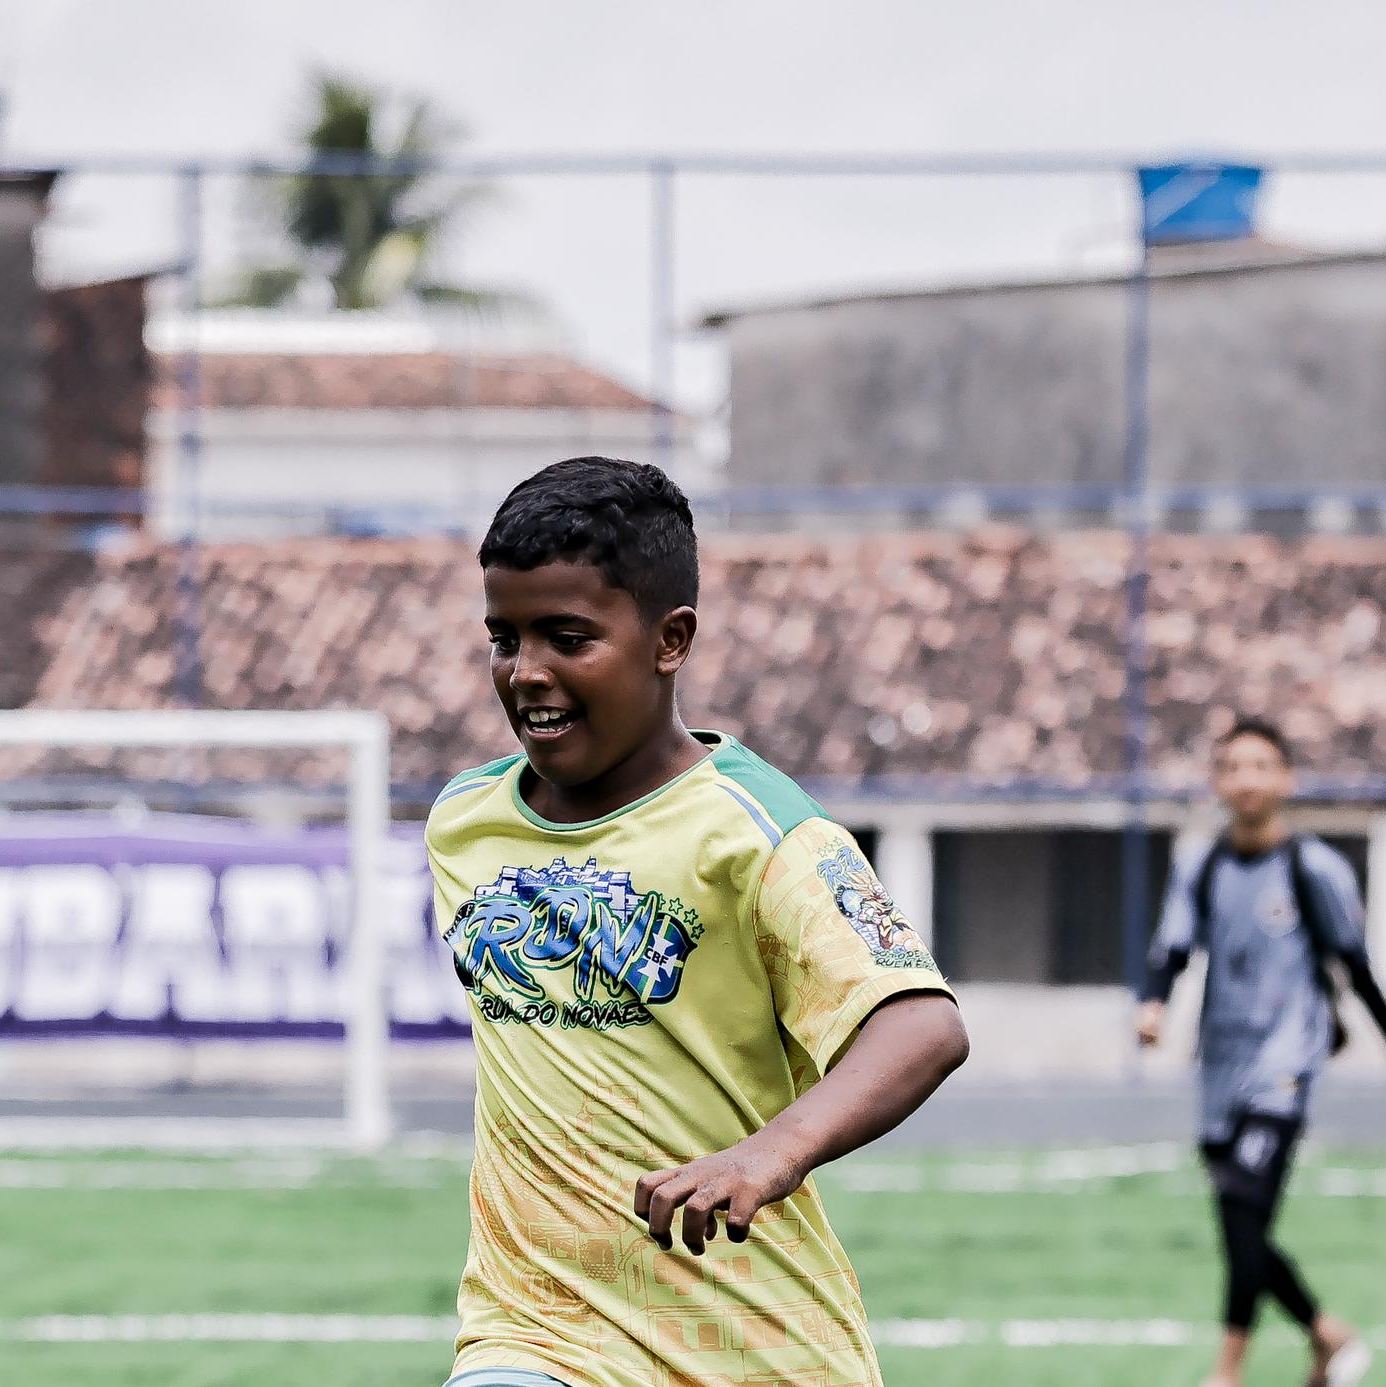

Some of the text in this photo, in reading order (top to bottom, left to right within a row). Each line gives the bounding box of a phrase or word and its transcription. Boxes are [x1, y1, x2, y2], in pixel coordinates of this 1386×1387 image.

[644, 947, 668, 967] CBF
[480, 995, 655, 1030] RUA DO NOVAES
